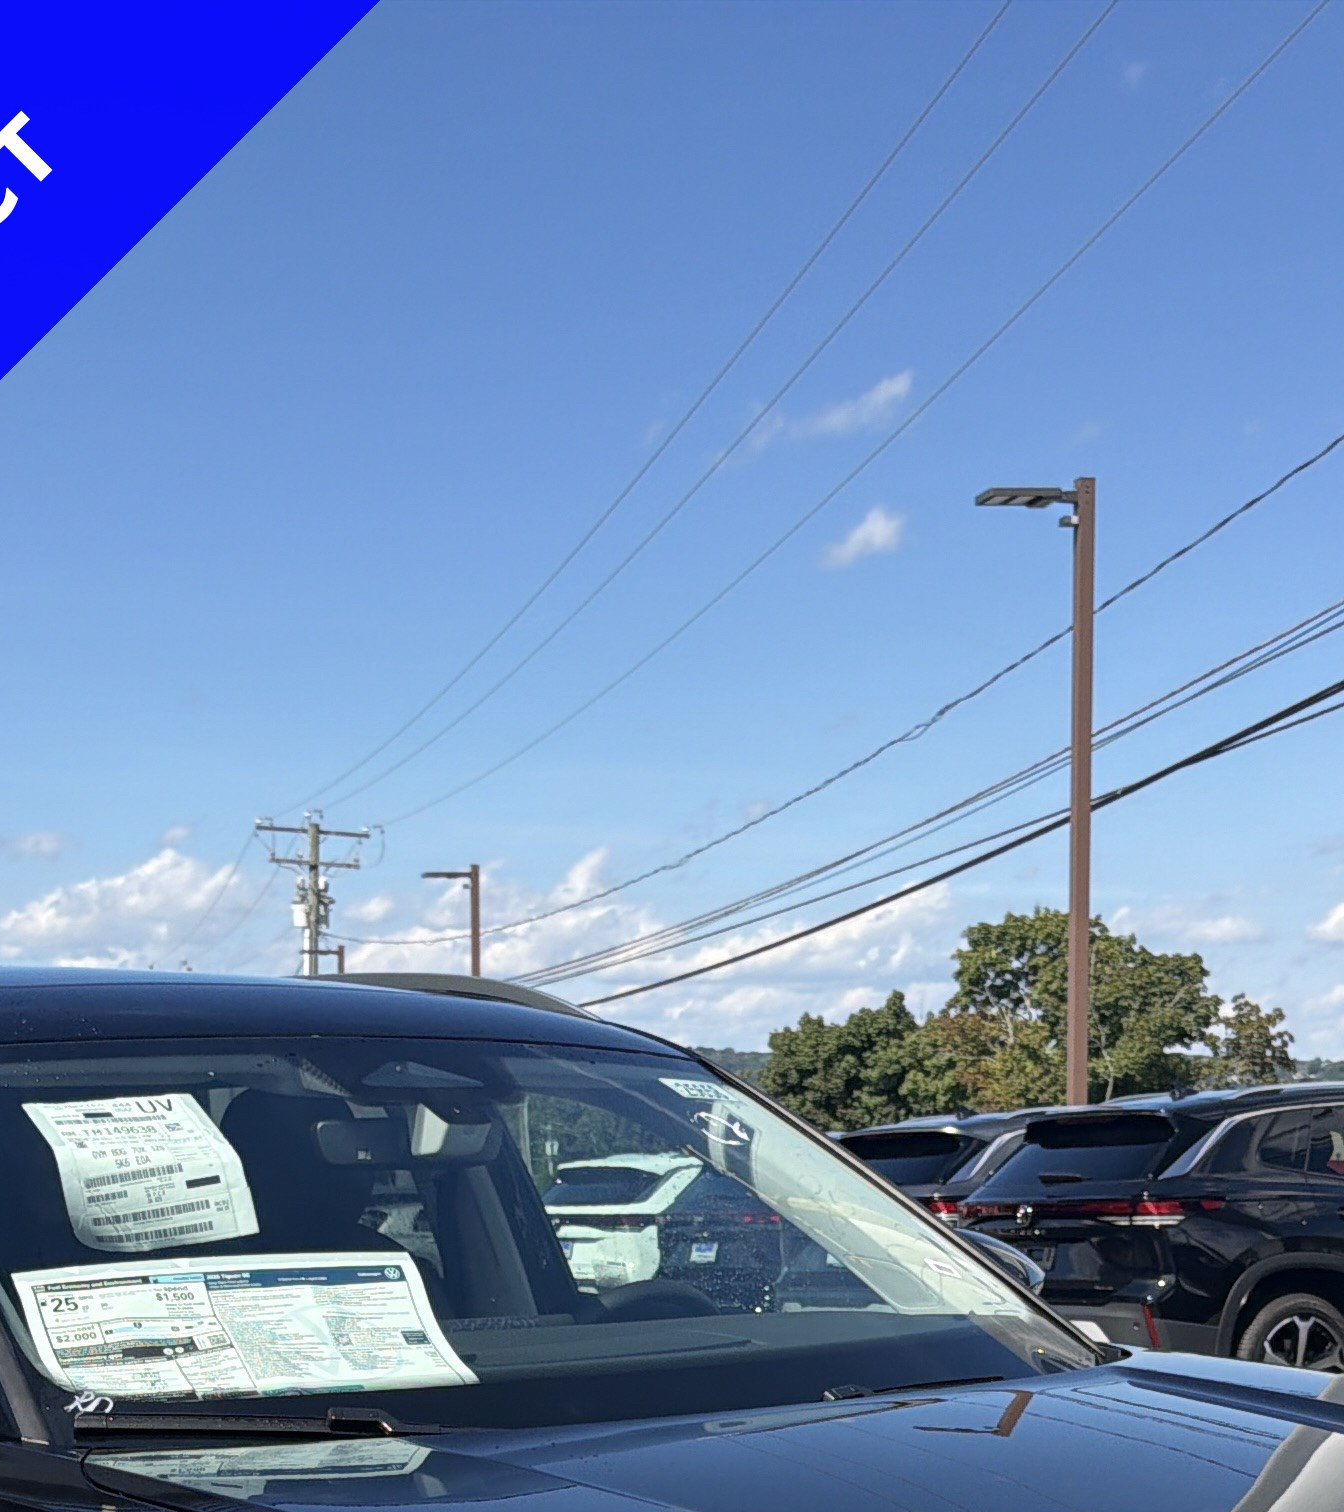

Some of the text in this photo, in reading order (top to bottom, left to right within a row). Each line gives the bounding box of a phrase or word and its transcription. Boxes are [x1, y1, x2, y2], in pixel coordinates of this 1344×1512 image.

[135, 1098, 173, 1114] UV
[156, 1291, 195, 1302] $1,500
[50, 1297, 79, 1313] 25
[56, 1332, 97, 1343] $2,000
